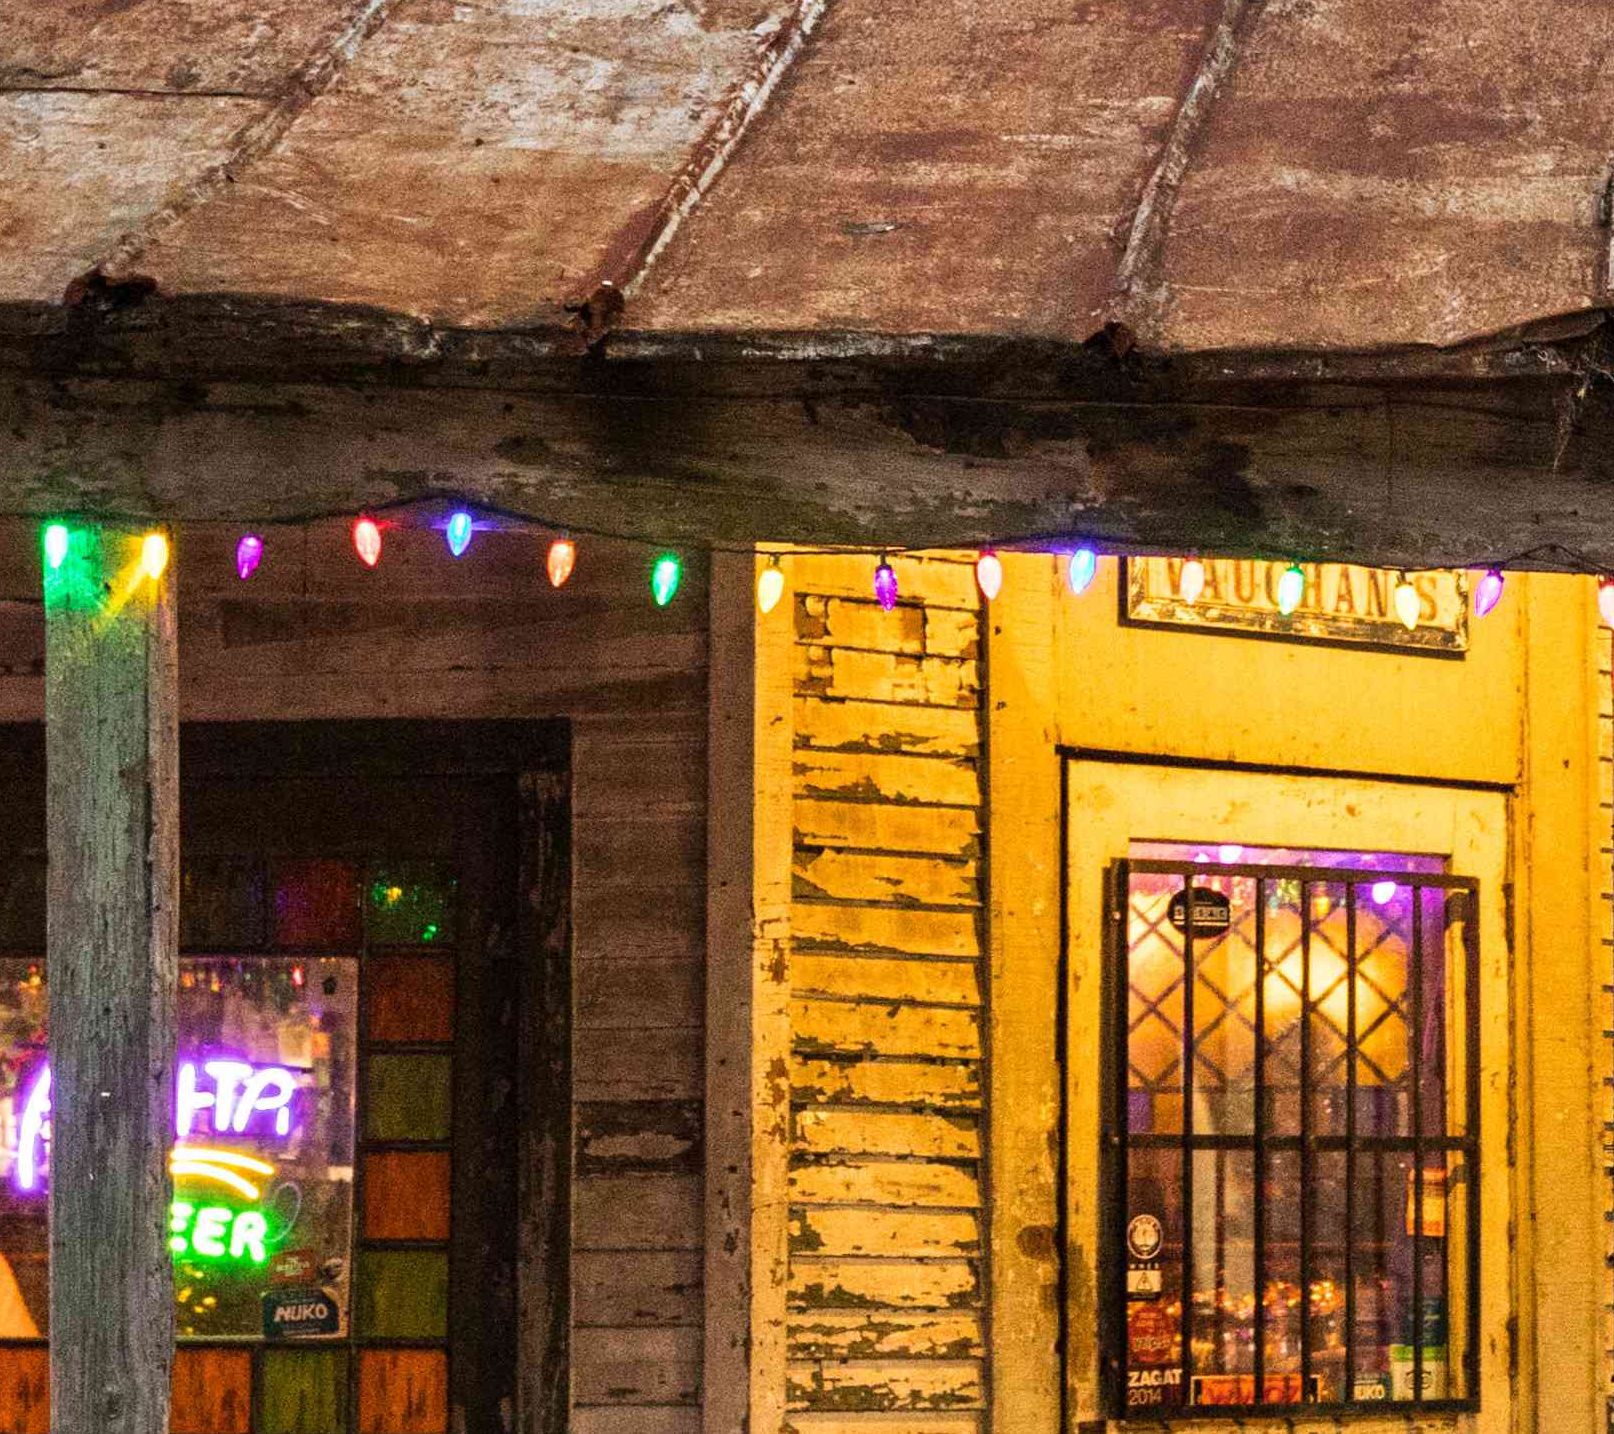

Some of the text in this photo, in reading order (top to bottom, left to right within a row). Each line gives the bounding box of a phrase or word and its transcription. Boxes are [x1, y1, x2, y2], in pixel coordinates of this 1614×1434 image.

[171, 1203, 270, 1263] EER
[273, 1302, 330, 1323] NUKO
[1128, 1369, 1183, 1387] ZAGAT
[1129, 1387, 1163, 1406] 2014
